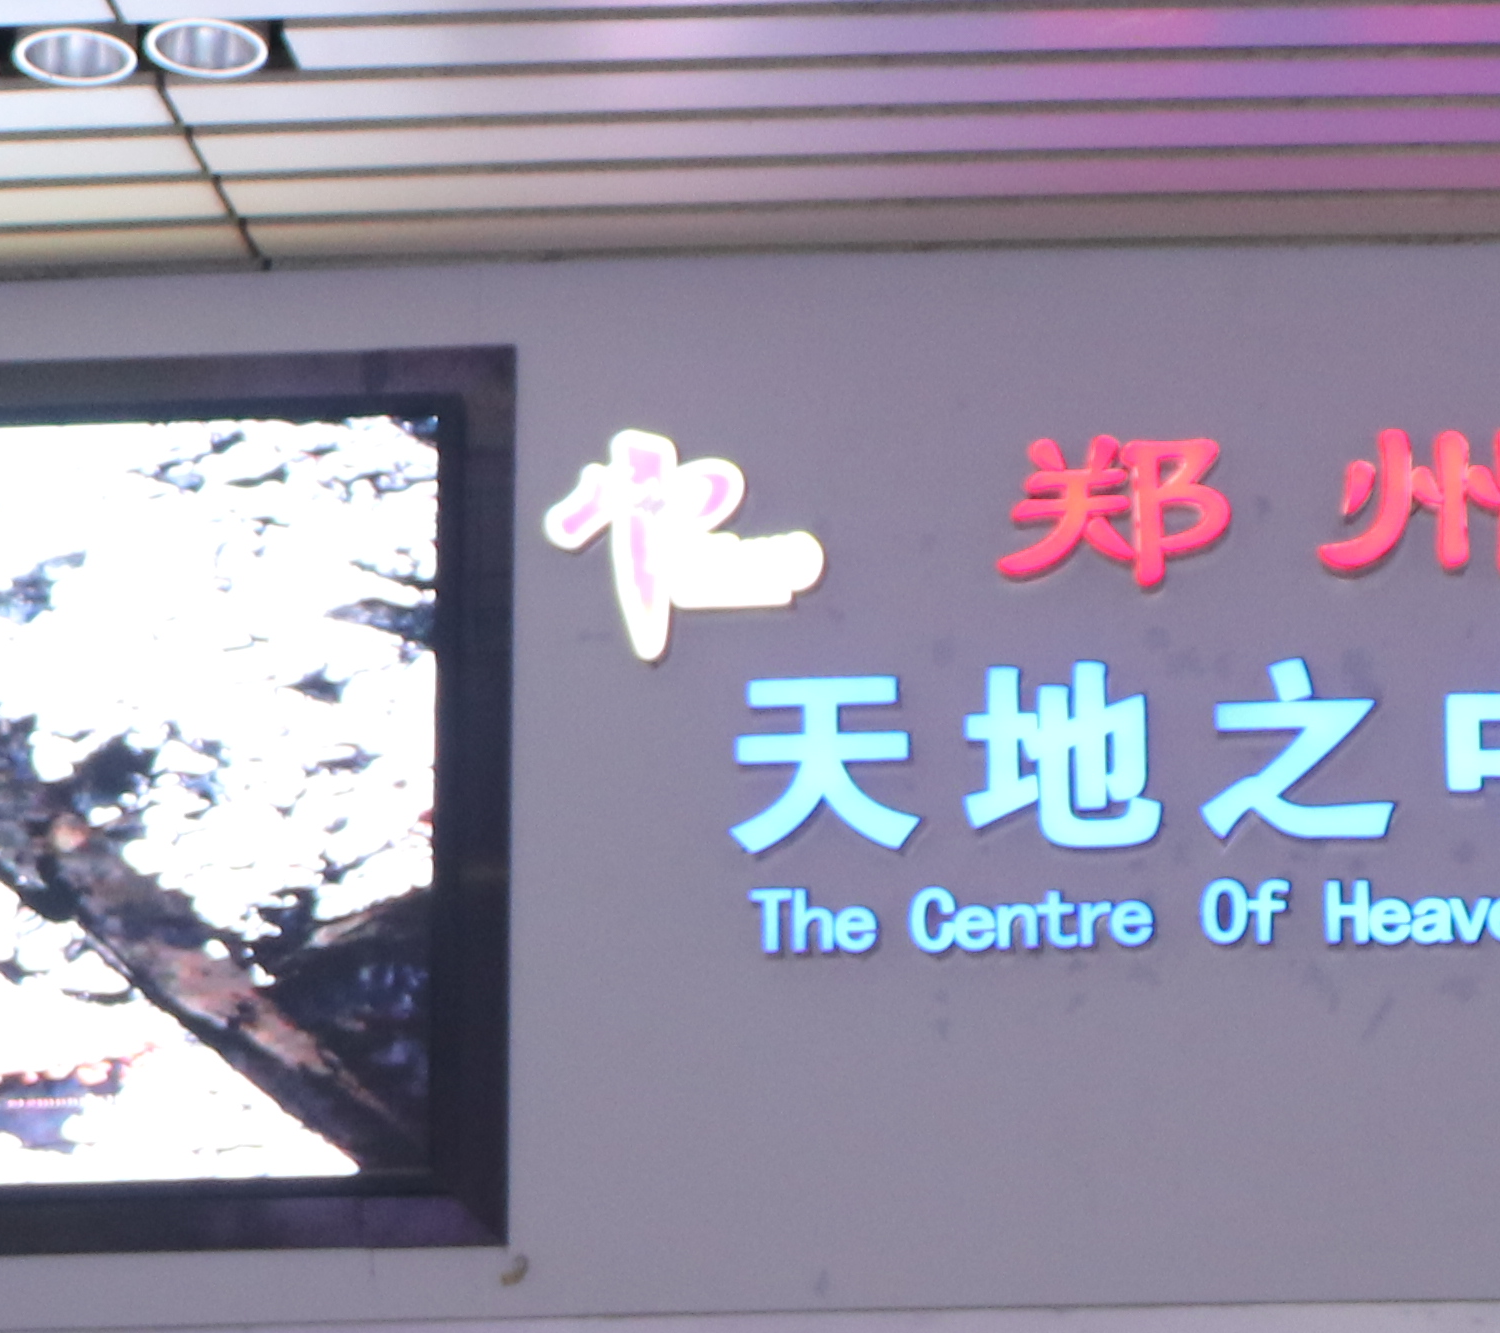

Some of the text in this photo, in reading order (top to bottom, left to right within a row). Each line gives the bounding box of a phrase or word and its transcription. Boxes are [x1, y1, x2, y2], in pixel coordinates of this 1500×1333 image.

[750, 887, 878, 952] The
[909, 886, 1154, 952] Centre
[1201, 878, 1290, 944] Of
